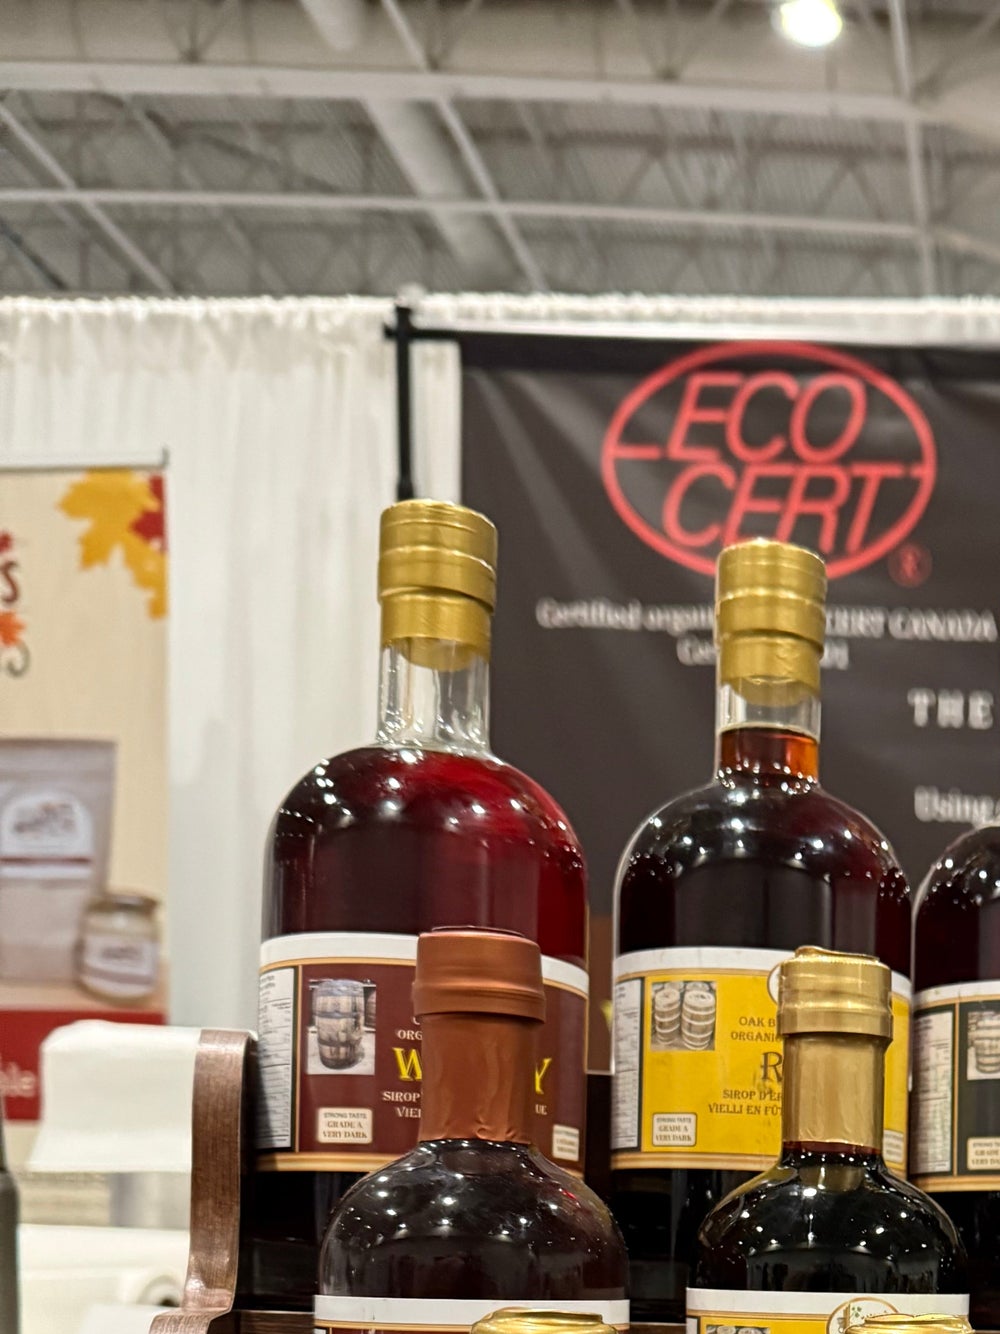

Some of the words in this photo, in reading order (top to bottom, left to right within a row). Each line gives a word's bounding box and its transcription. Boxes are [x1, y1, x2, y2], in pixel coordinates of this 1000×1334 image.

[667, 372, 866, 463] ECO
[663, 462, 905, 556] CERT
[536, 597, 641, 631] Certified
[888, 606, 998, 643] CANADA
[907, 687, 994, 730] THE
[914, 785, 1000, 826] Using
[738, 1016, 765, 1028] OAK
[708, 1103, 744, 1115] VIELLI
[745, 1104, 761, 1116] EN
[722, 1089, 756, 1101] SIROP
